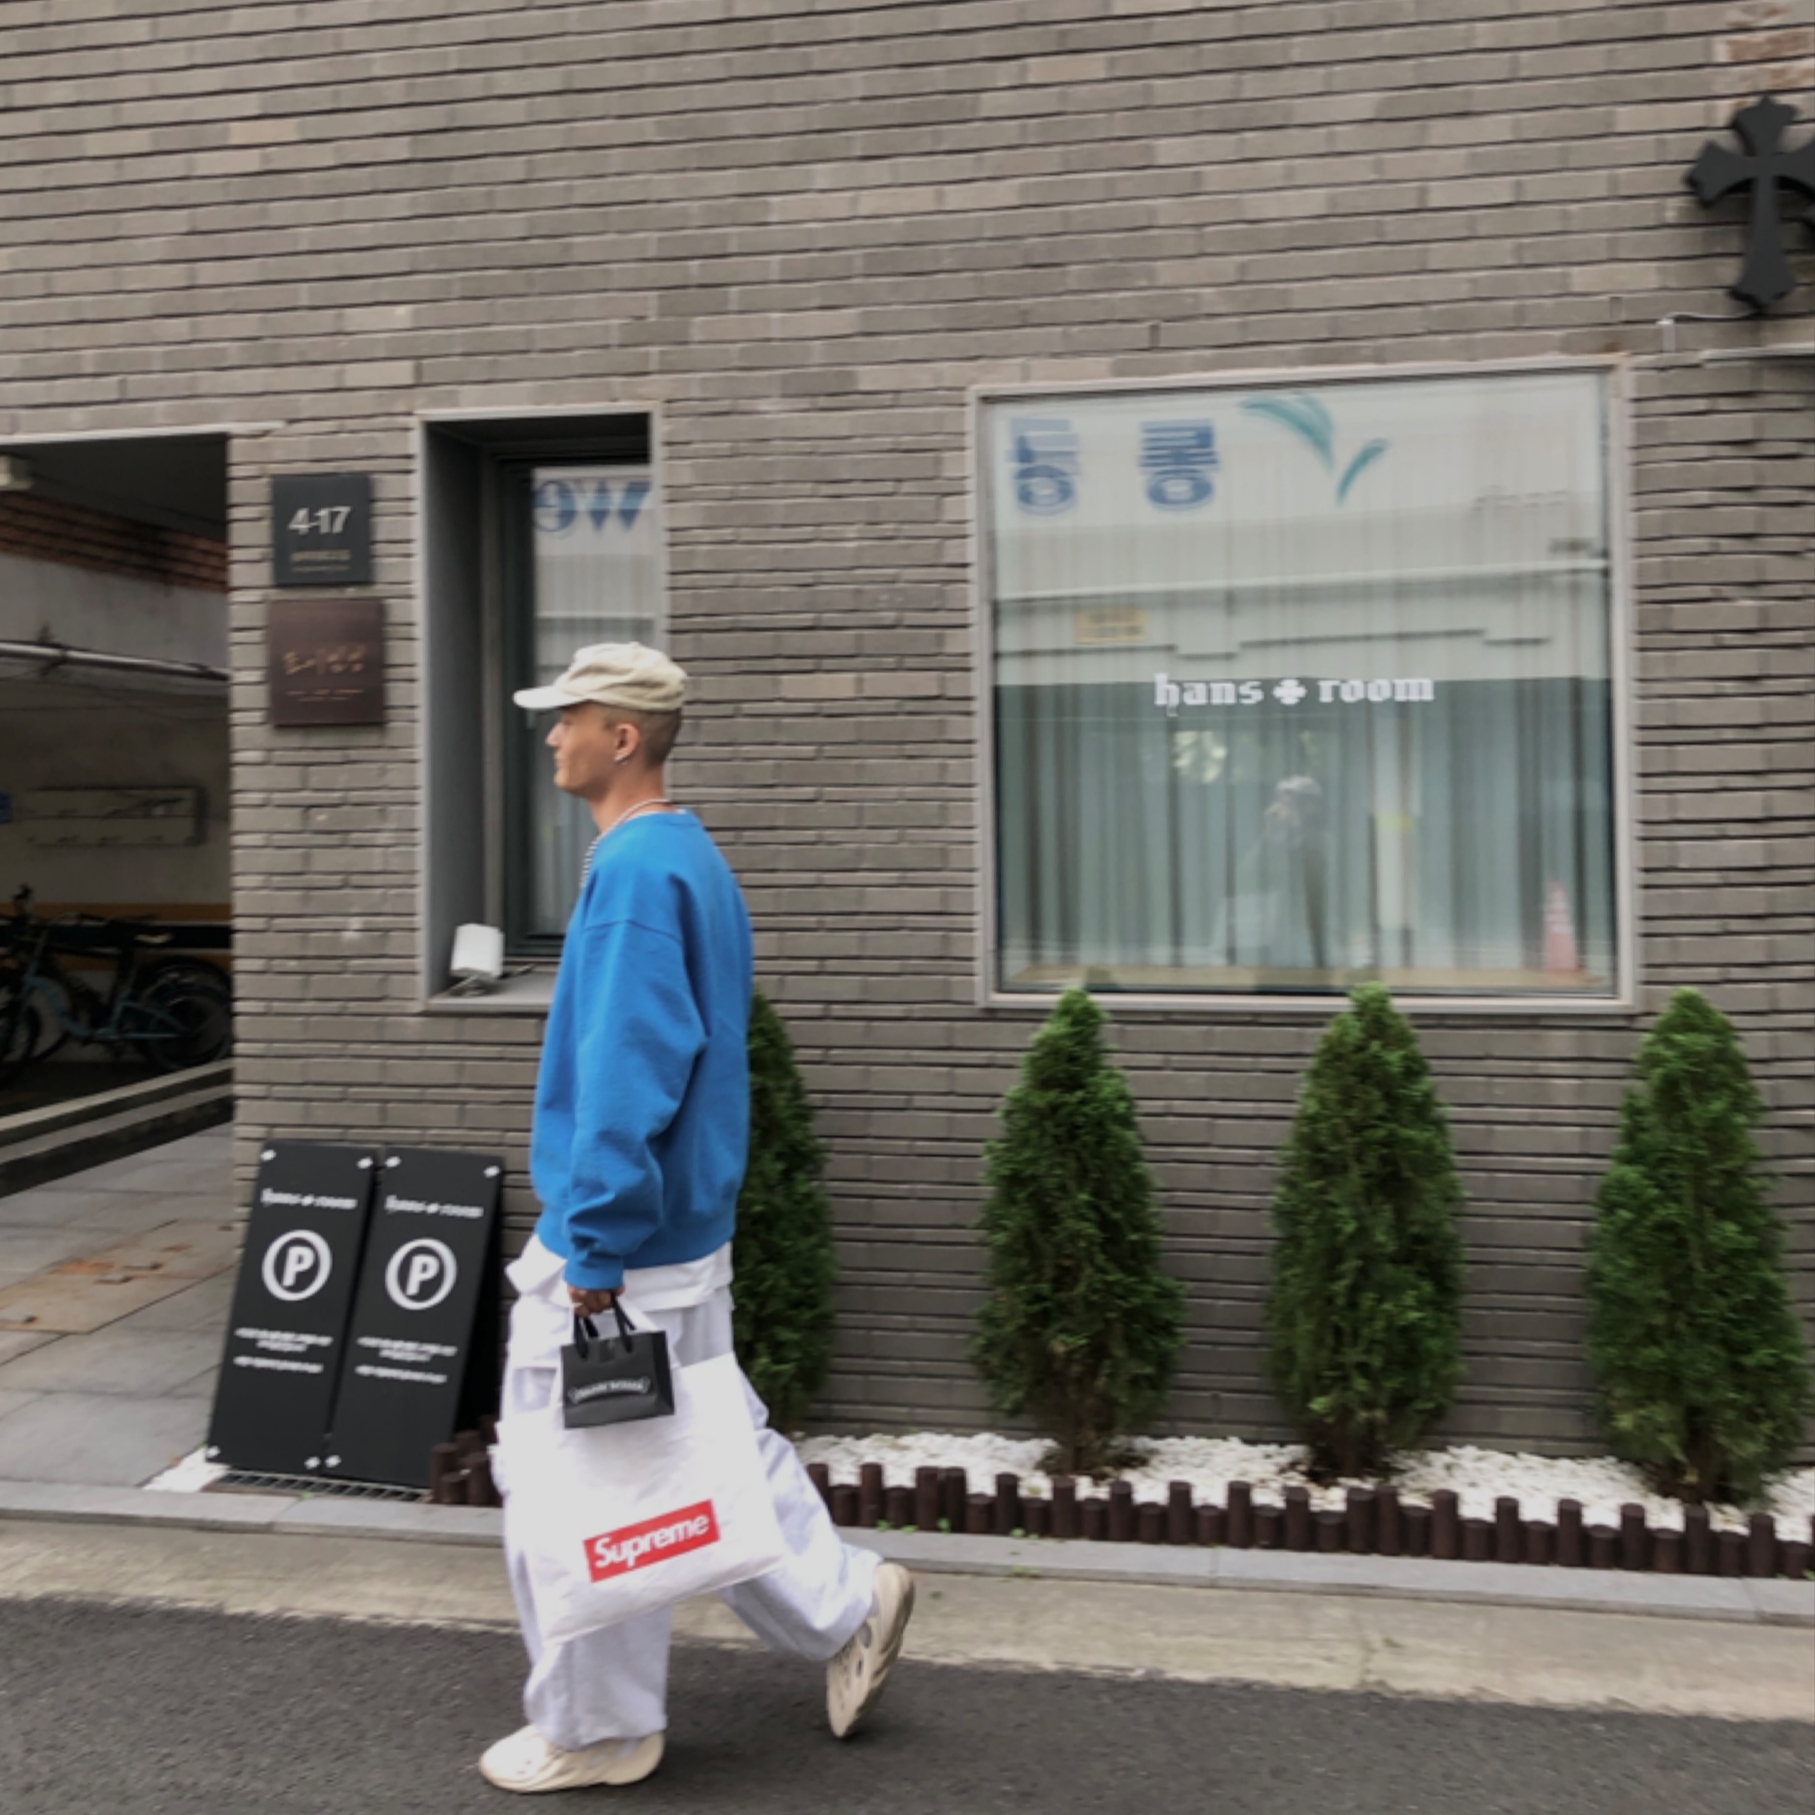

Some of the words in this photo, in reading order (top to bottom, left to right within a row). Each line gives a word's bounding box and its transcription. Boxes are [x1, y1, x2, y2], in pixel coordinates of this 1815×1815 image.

[1154, 672, 1264, 717] hans
[1316, 678, 1436, 703] room
[282, 1245, 316, 1288] P
[406, 1254, 440, 1297] P
[593, 1513, 710, 1569] Supreme
